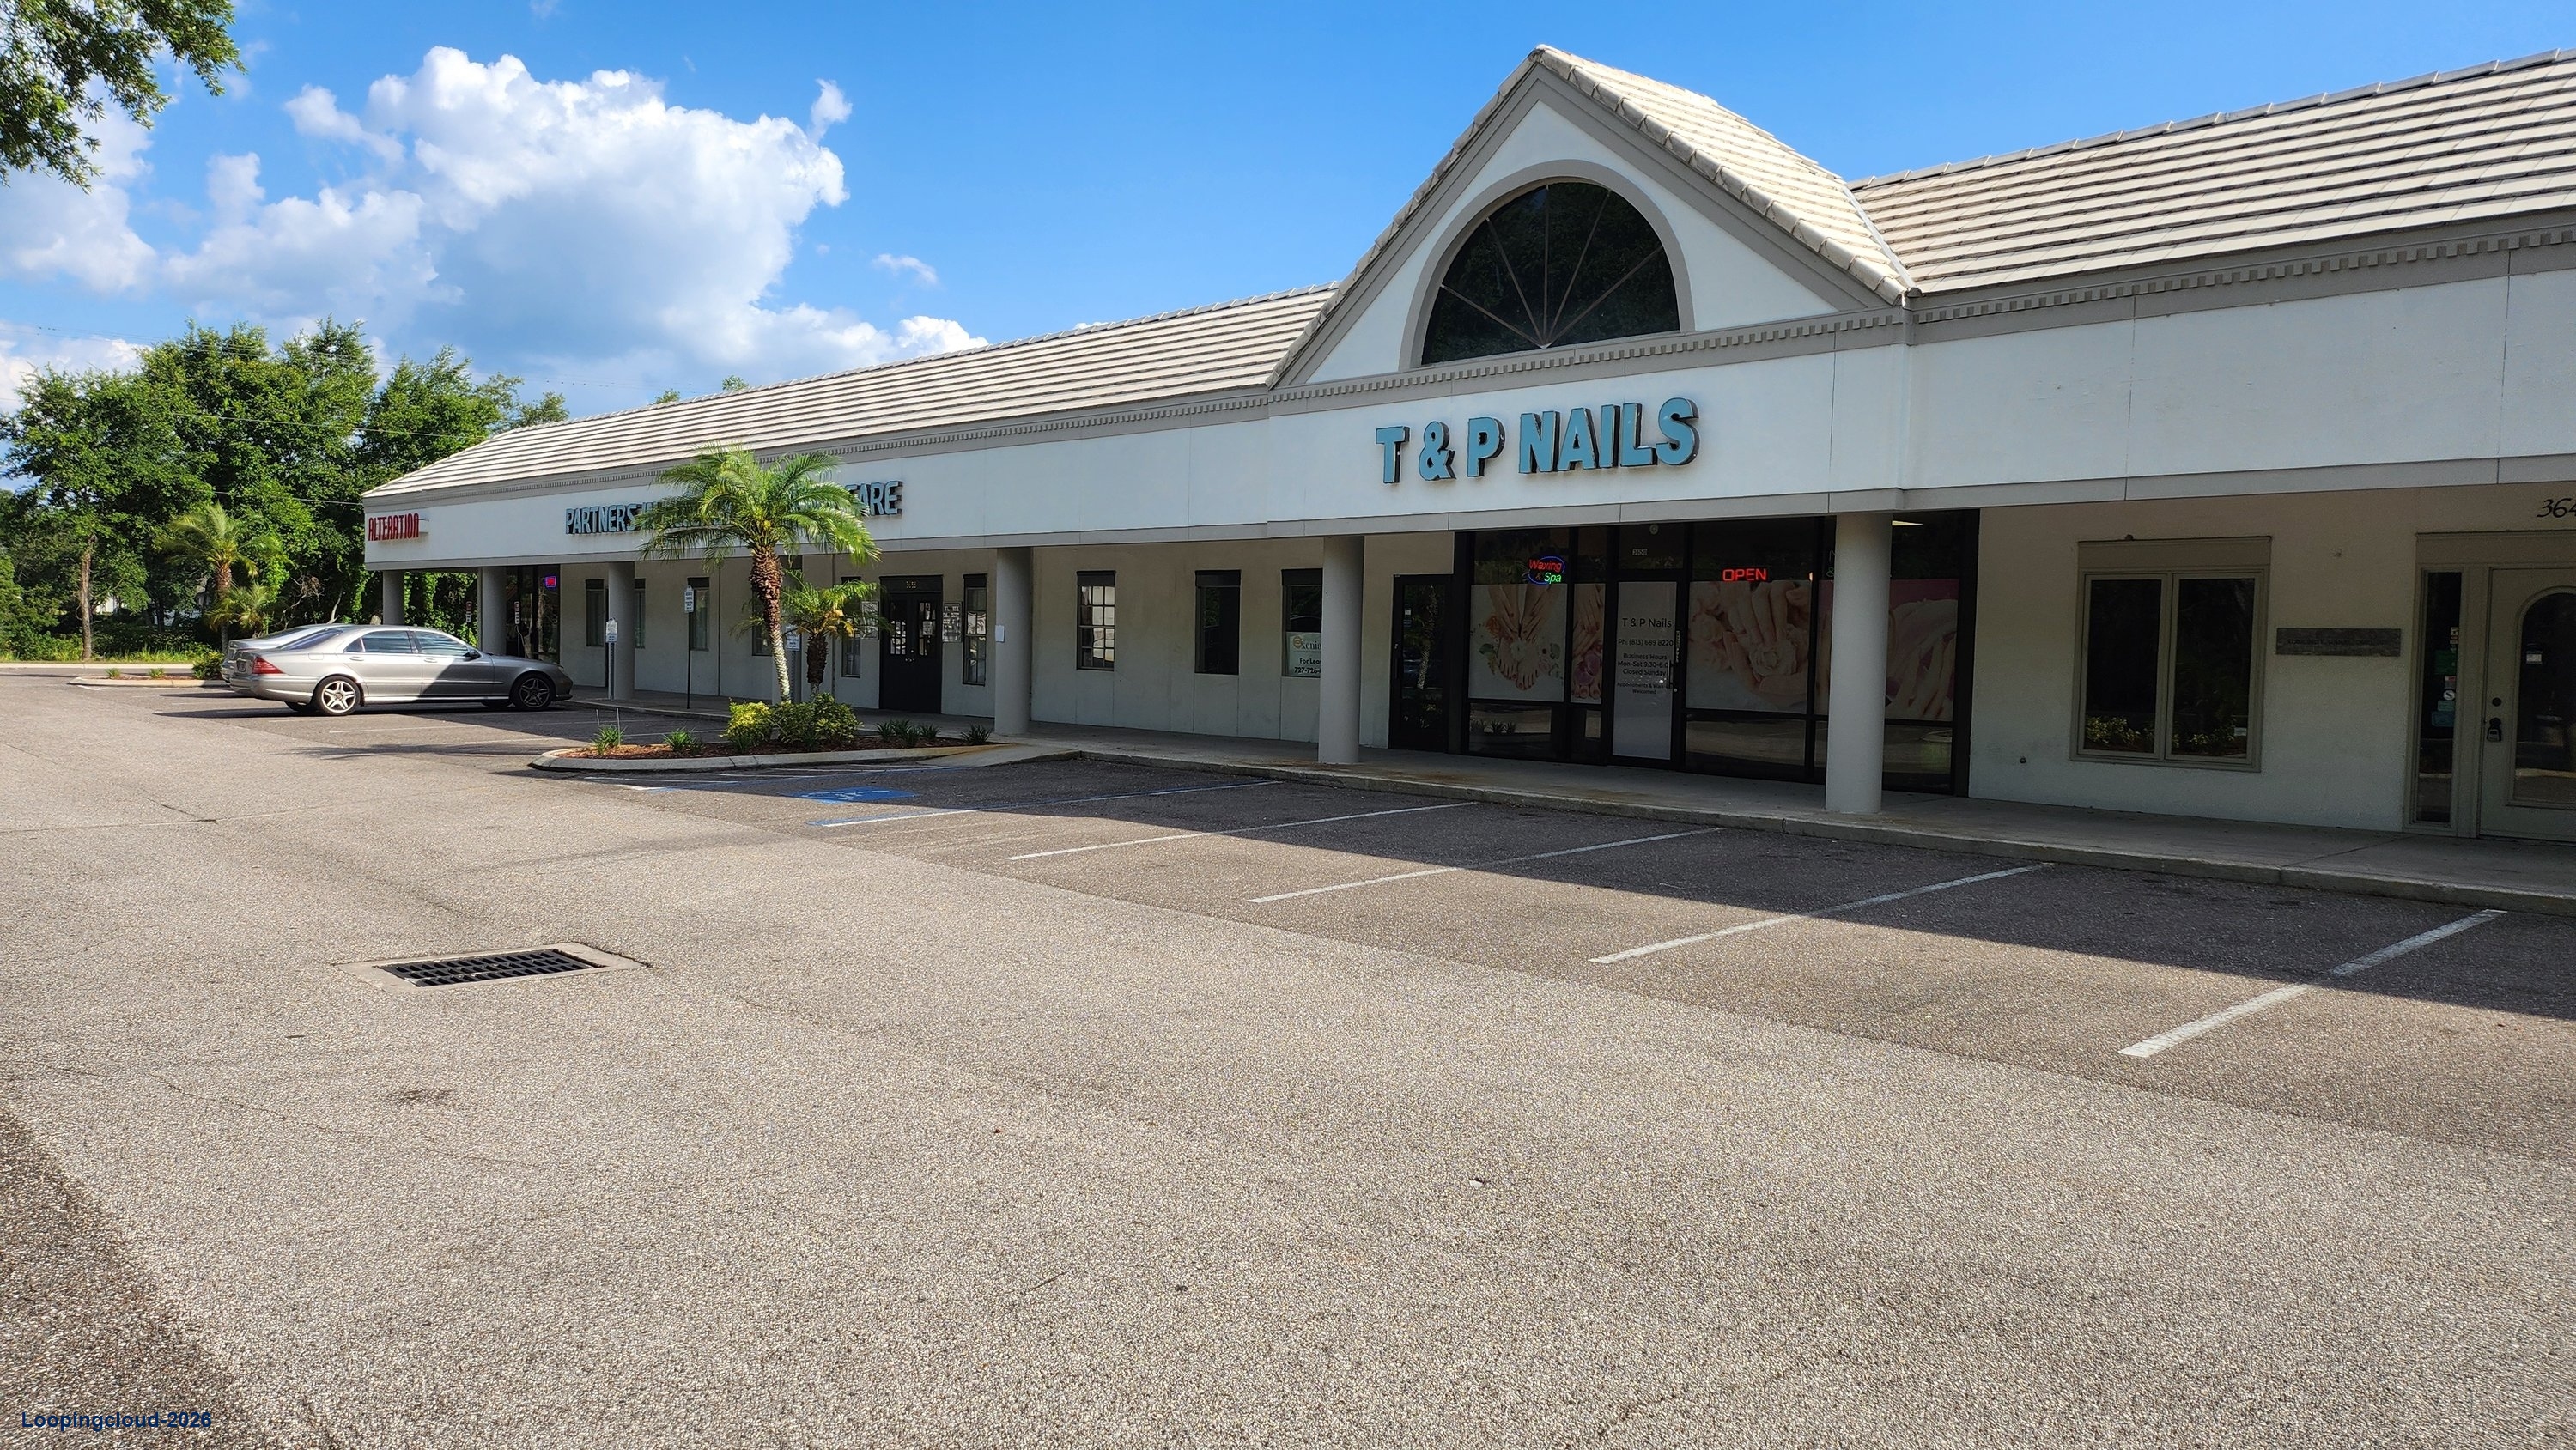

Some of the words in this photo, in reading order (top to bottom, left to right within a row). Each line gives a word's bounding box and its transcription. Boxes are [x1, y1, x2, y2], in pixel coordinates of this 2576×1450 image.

[1376, 425, 1410, 484] T
[1419, 421, 1456, 482] &
[1467, 416, 1505, 477] P
[1518, 397, 1700, 474] NAILS
[565, 503, 637, 535] PARTNERS
[368, 513, 419, 541] ALTERATION
[1528, 559, 1562, 573] Waxing
[1544, 573, 1562, 584] Spa
[1722, 568, 1767, 581] OPEN
[1622, 617, 1628, 627] T
[1630, 617, 1637, 627] &
[1639, 618, 1646, 627] P
[1649, 617, 1672, 628] Nails
